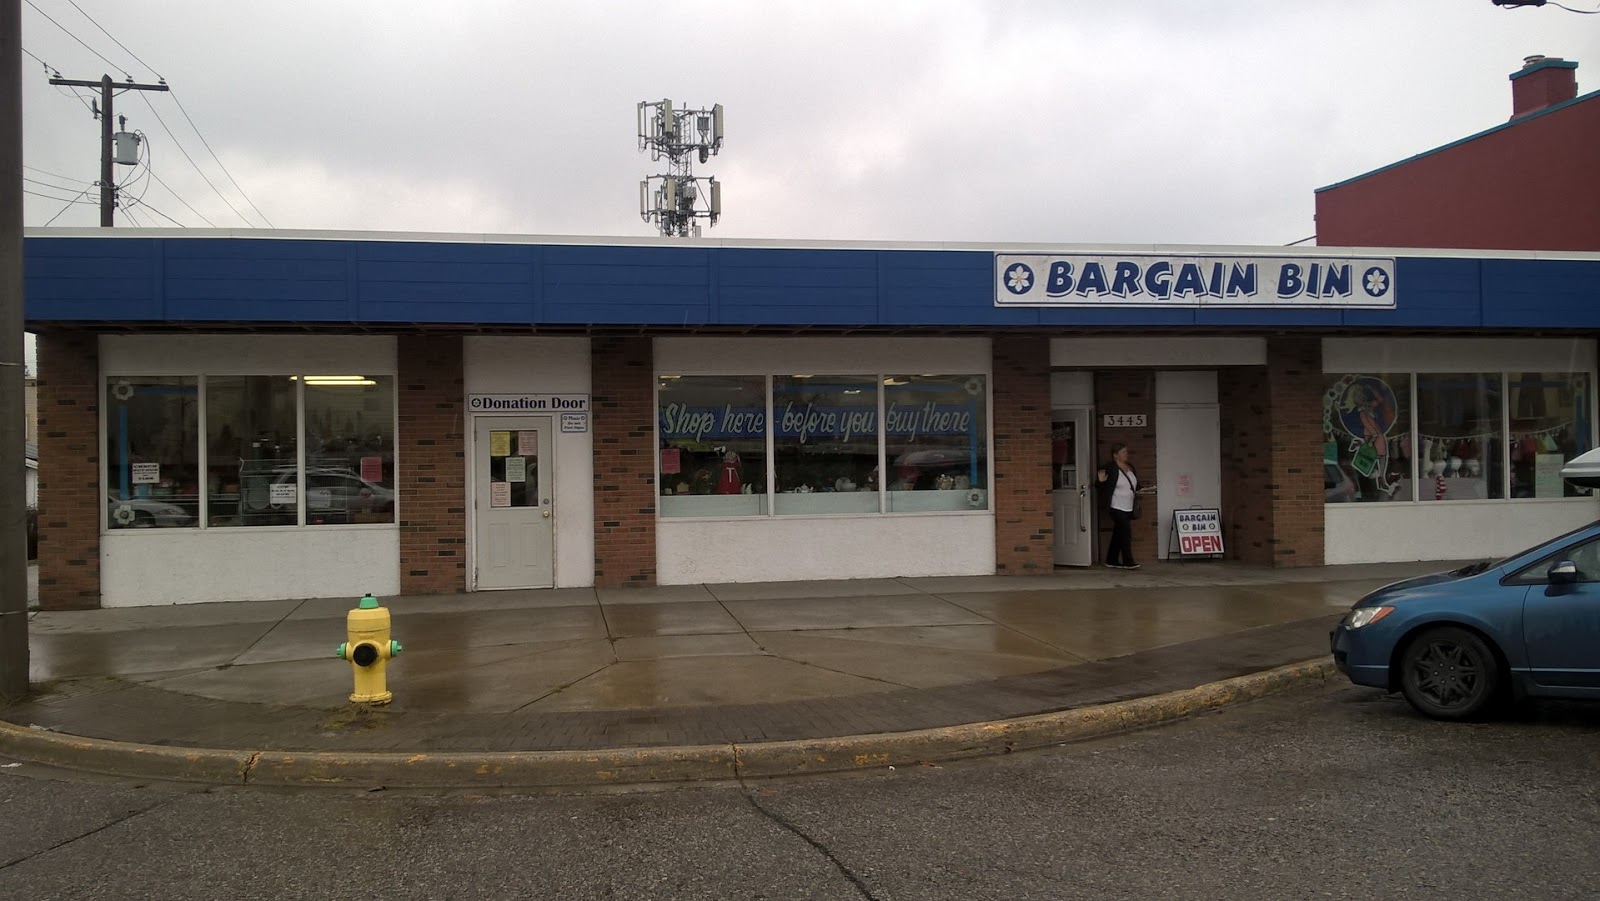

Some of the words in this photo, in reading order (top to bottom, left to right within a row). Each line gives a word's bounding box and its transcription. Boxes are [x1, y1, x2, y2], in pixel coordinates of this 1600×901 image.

[1046, 260, 1257, 300] BARGAIN
[1276, 263, 1353, 299] BIN
[482, 397, 546, 409] Donation
[551, 397, 586, 409] Door
[663, 402, 716, 443] Shop
[720, 403, 764, 433] here
[782, 401, 836, 444] before
[840, 410, 875, 443] you
[886, 401, 920, 442] buy
[921, 401, 970, 433] there
[1107, 415, 1143, 426] 3445
[1179, 513, 1216, 521] BARGAIN
[1192, 523, 1206, 531] BIN
[1181, 535, 1222, 553] OPEN
